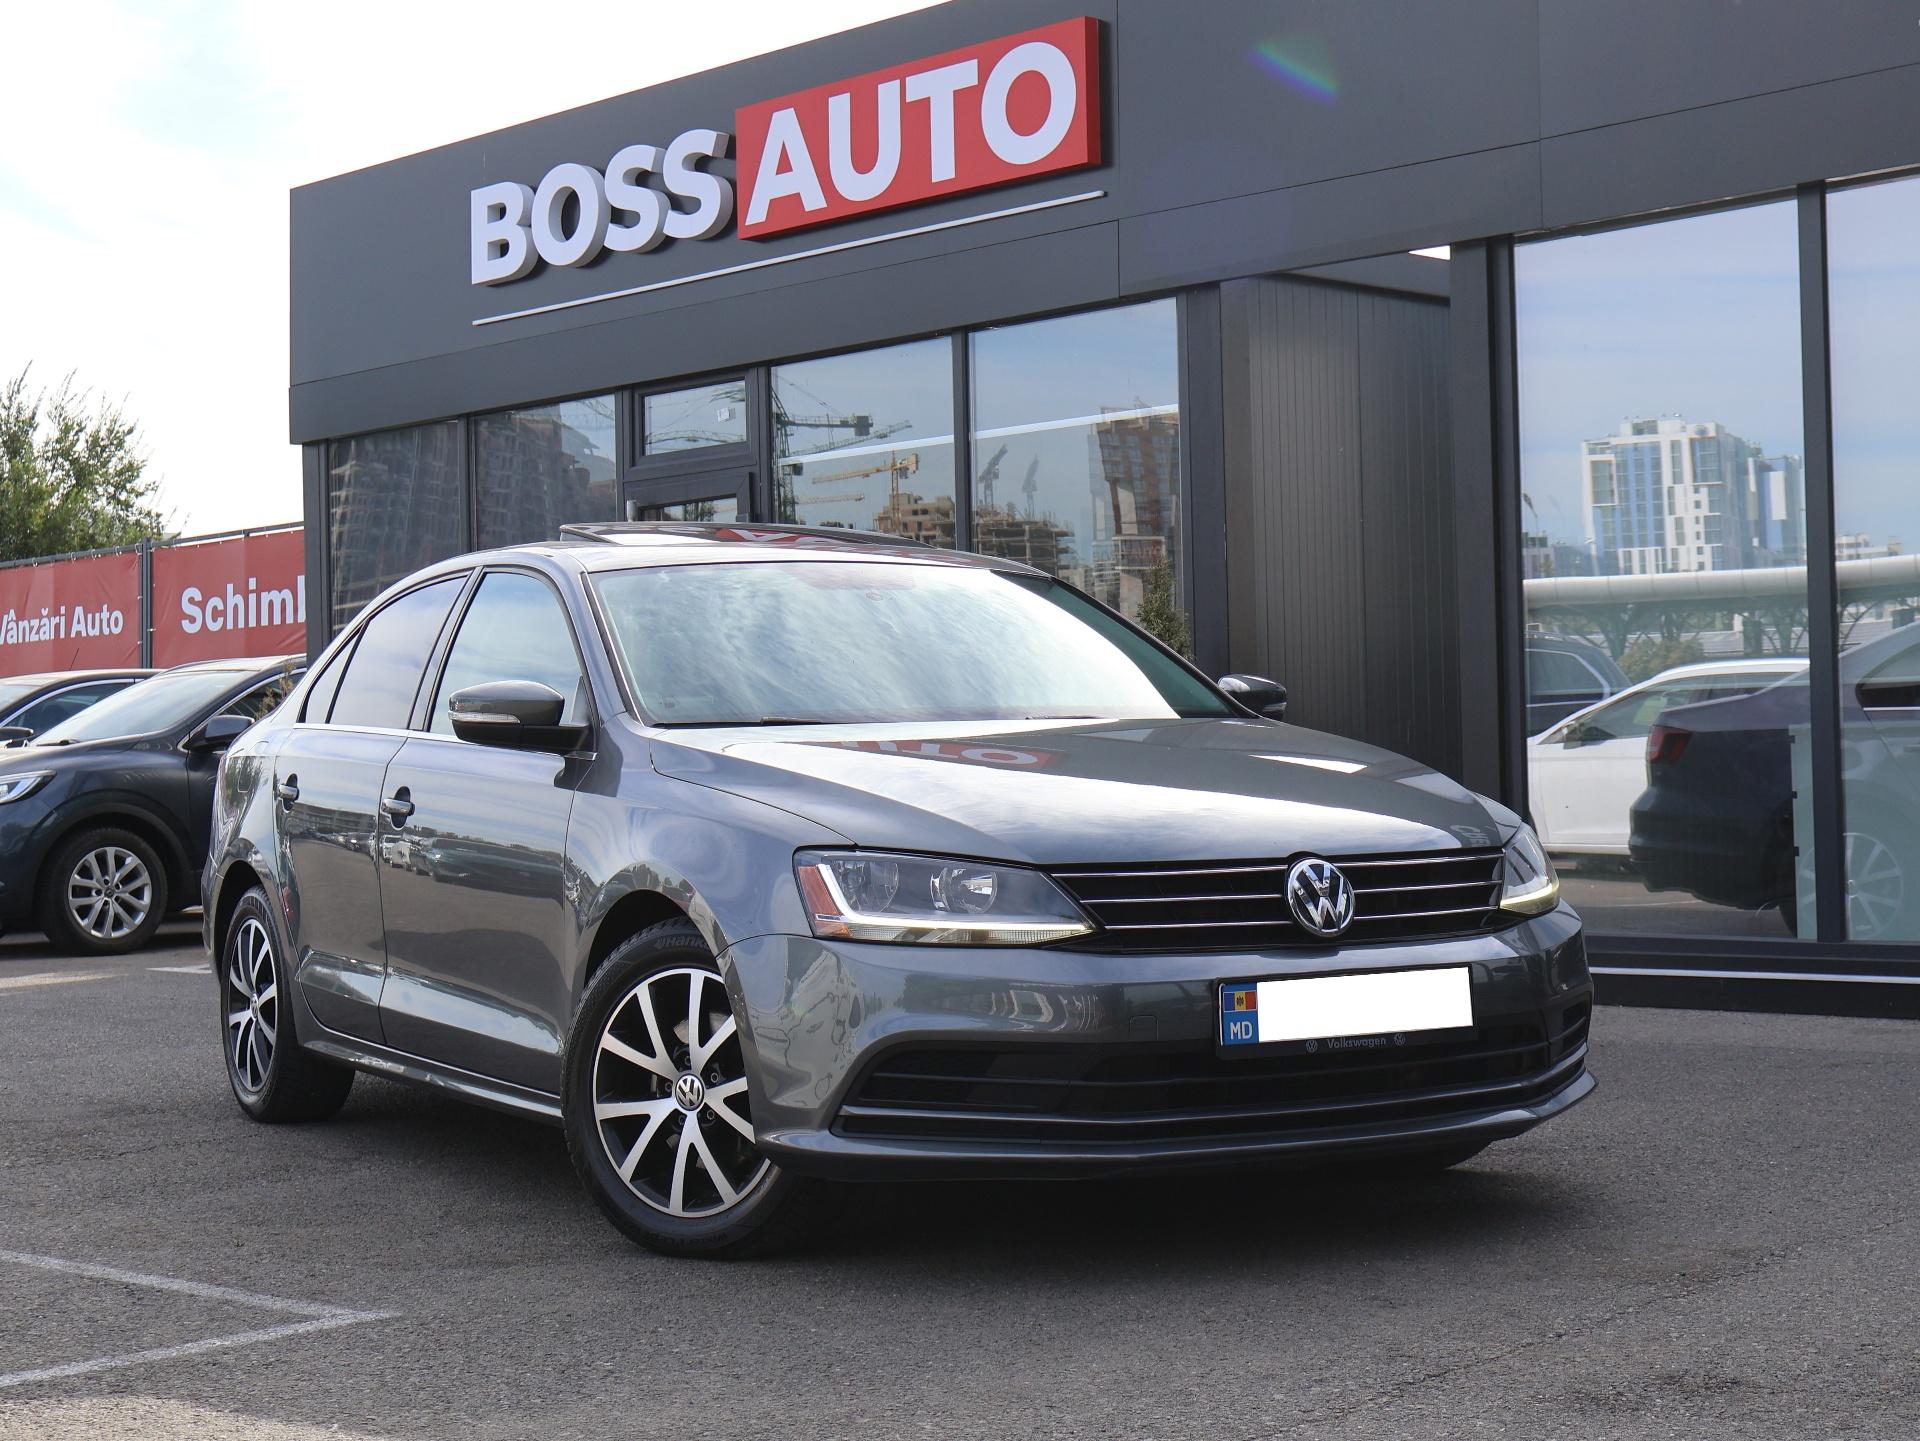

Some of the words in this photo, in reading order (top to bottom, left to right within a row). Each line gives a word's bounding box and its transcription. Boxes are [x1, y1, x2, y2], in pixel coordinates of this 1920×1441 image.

[471, 128, 731, 286] BOSS
[744, 41, 1077, 226] AUTO
[70, 604, 124, 638] Auto
[1229, 1021, 1253, 1040] MD
[1327, 1037, 1387, 1049] Volkswagen
